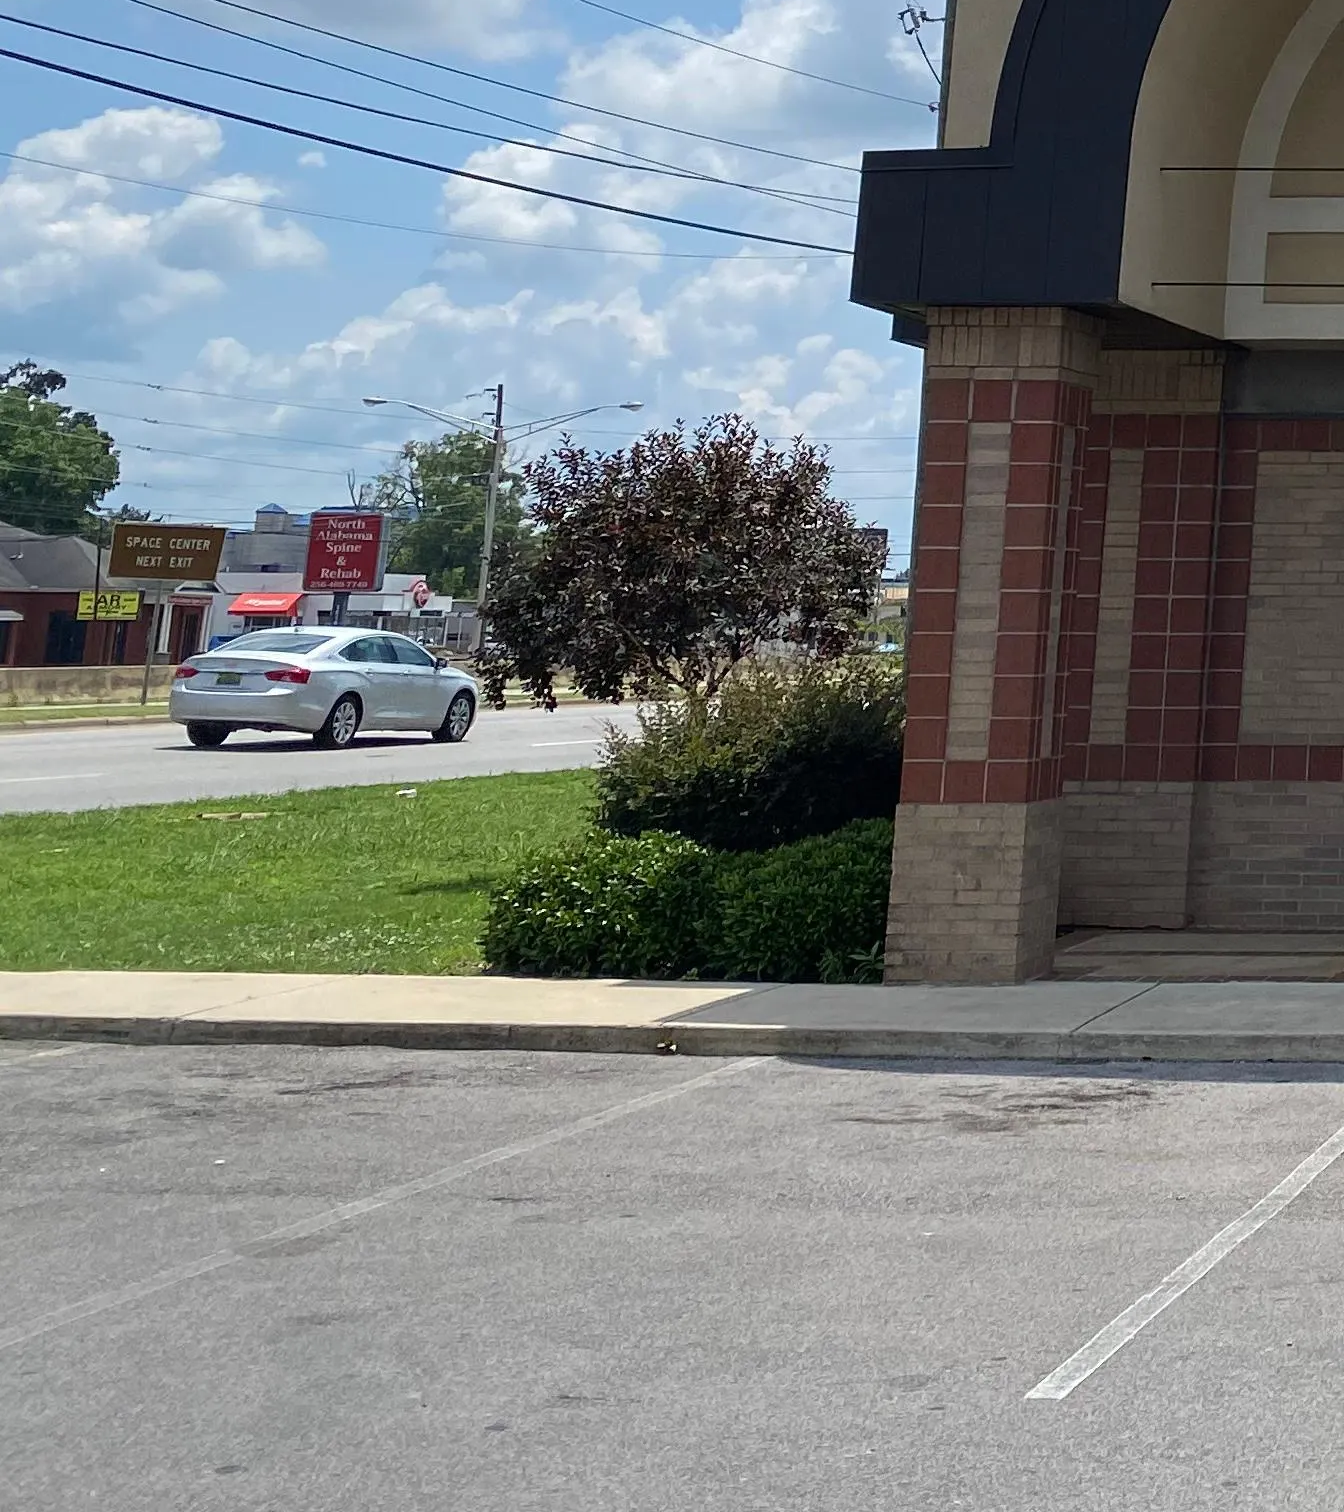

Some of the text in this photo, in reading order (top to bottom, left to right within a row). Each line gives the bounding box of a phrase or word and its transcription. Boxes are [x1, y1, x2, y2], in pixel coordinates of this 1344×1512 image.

[327, 519, 366, 529] North
[315, 530, 373, 541] Alabama
[126, 536, 211, 551] SPACE CENTER
[325, 541, 362, 555] Spine
[135, 555, 194, 568] NEXT EXIT
[336, 555, 346, 566] &
[320, 568, 362, 579] Rehab
